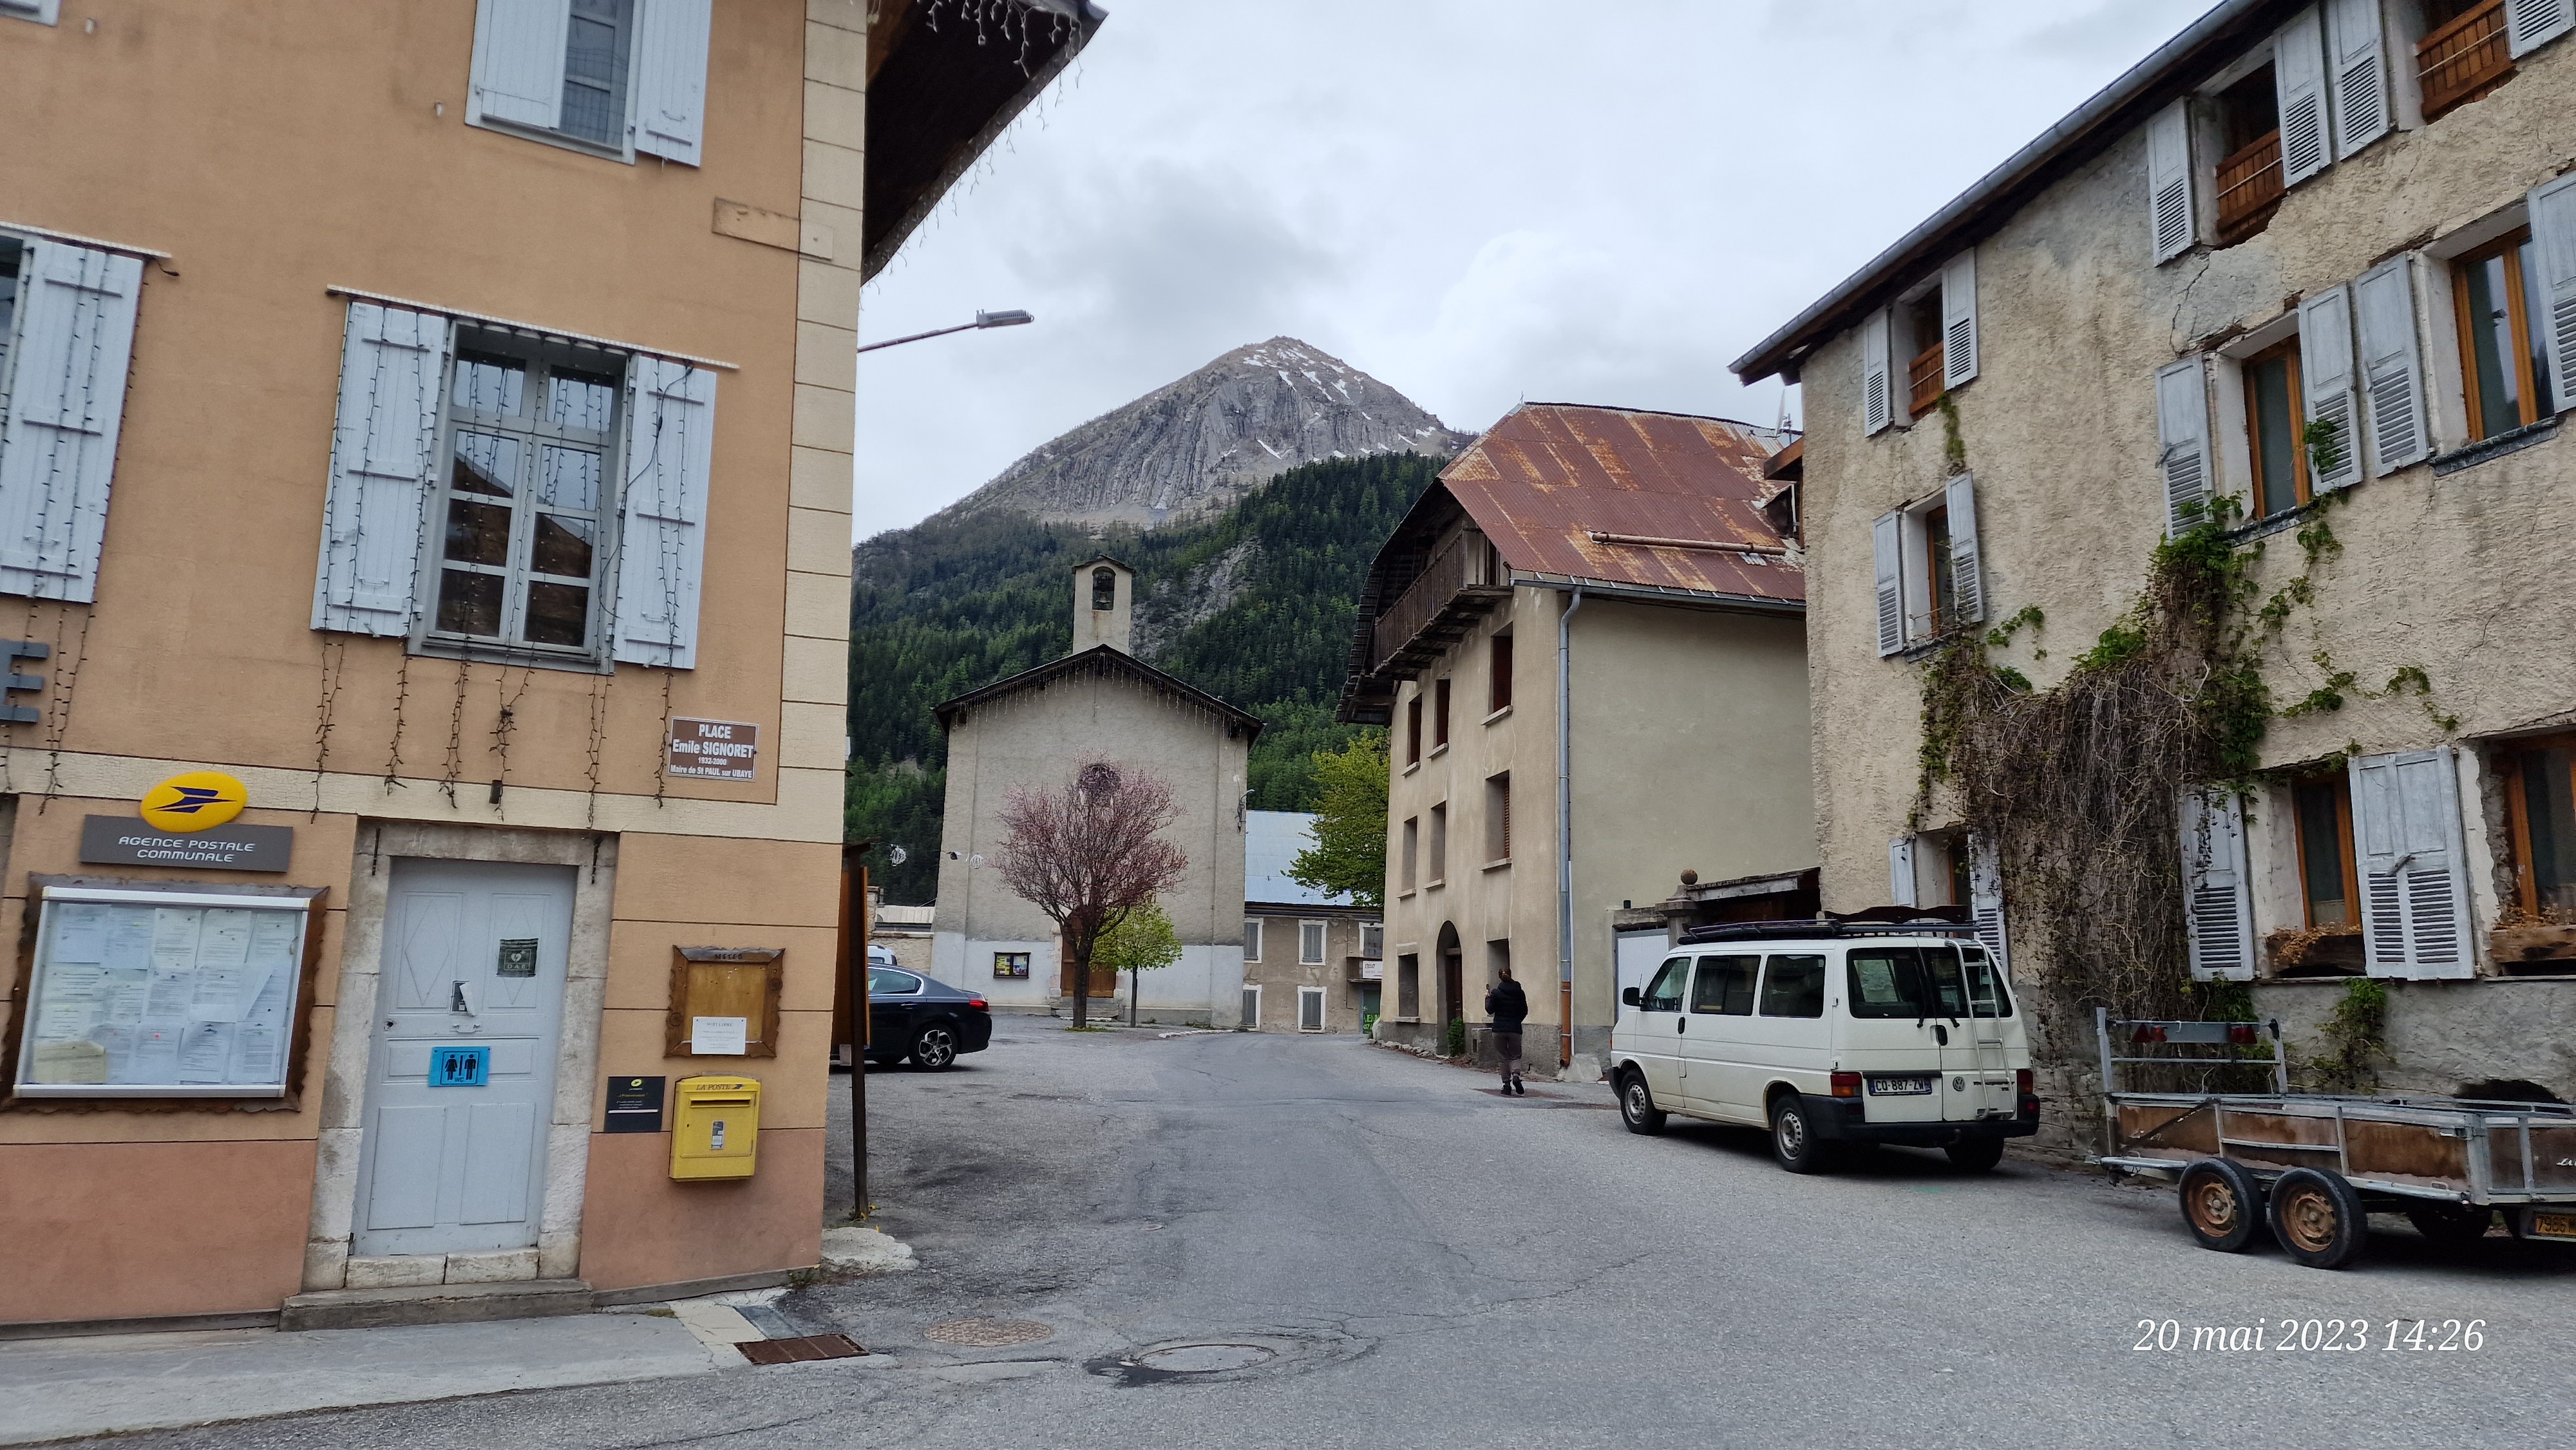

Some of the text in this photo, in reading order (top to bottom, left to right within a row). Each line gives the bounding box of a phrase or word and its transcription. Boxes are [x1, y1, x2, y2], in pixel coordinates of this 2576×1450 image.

[698, 724, 732, 739] PLACE
[672, 739, 753, 758] Emile SIGNORET
[697, 757, 726, 765] 1932-2000
[670, 764, 687, 773] Maire
[688, 766, 696, 775] de
[697, 766, 704, 775] St
[705, 767, 721, 776] PAUL
[732, 769, 752, 778] UBAYE
[118, 836, 256, 852] AGENCE POSTALE
[137, 849, 234, 863] COMMUNALE
